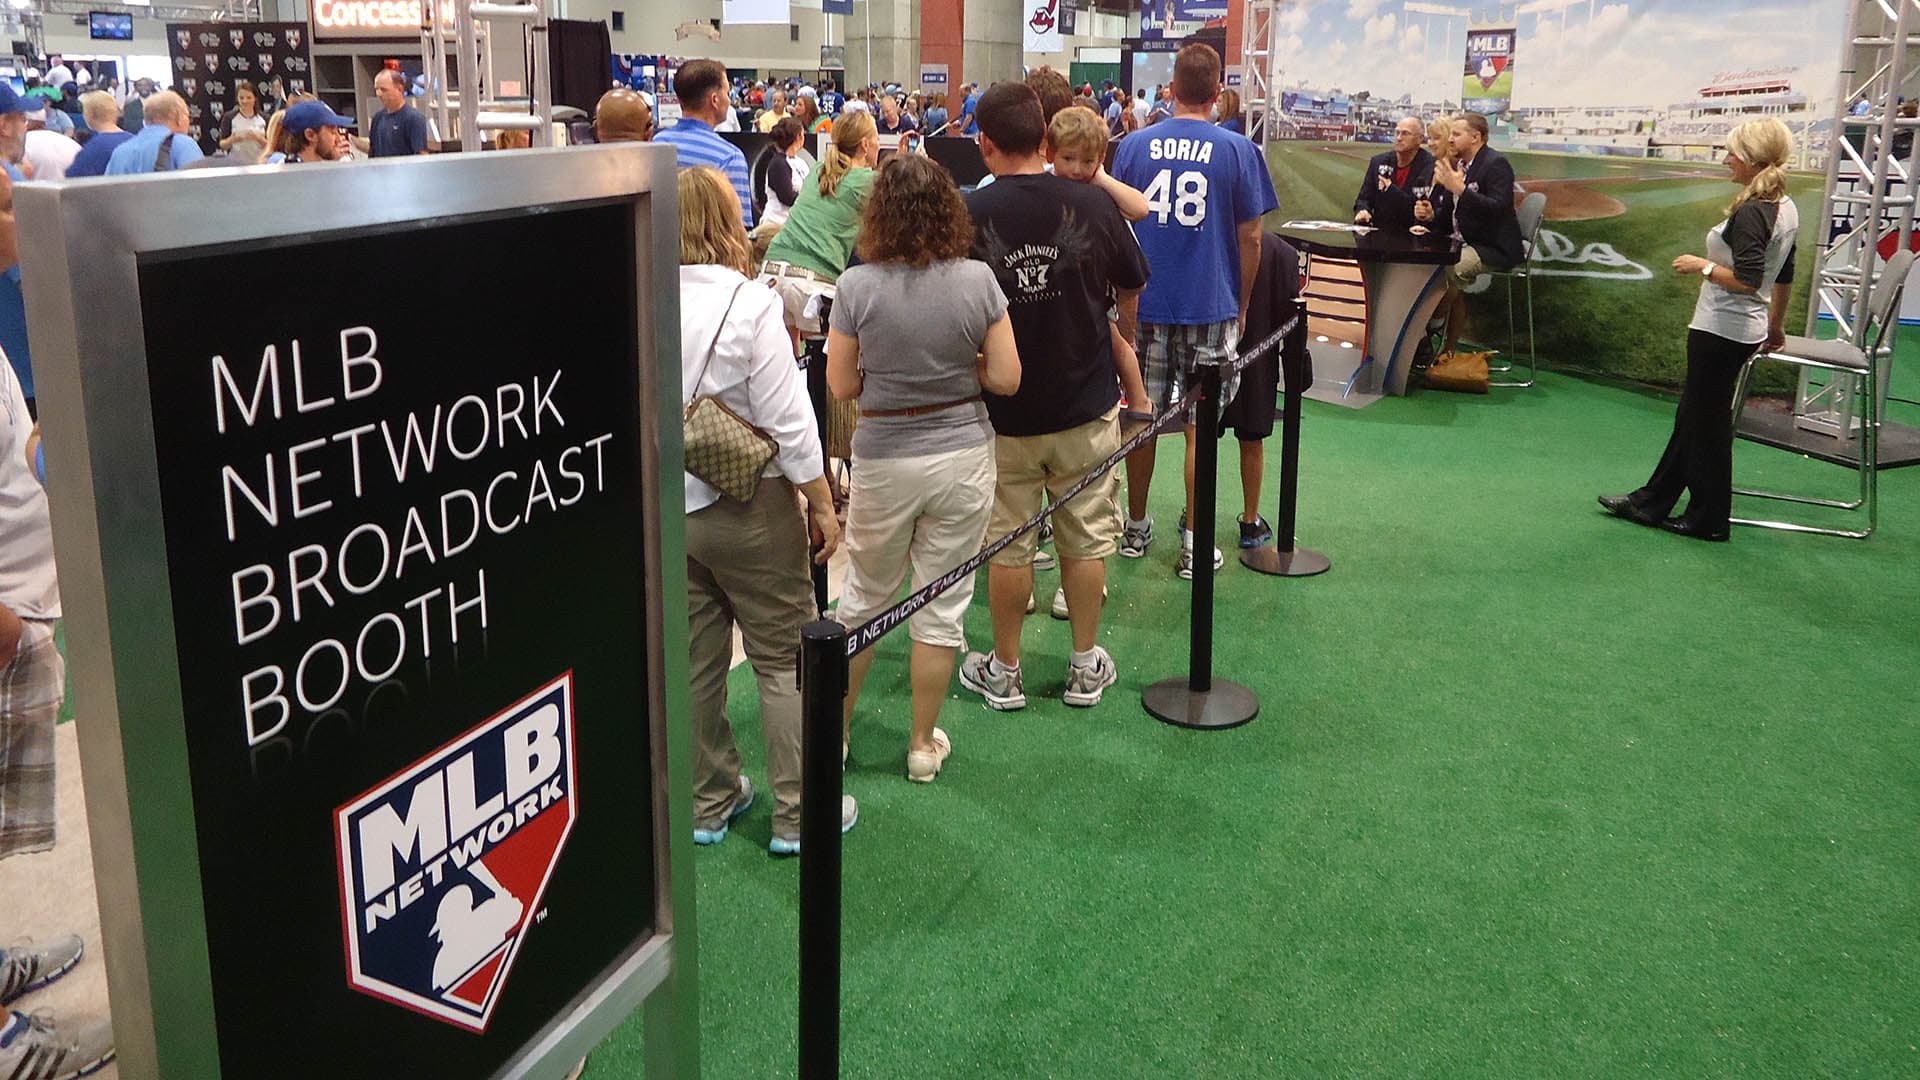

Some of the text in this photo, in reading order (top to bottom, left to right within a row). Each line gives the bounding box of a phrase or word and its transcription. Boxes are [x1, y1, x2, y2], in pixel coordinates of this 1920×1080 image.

[1473, 36, 1508, 51] MLB
[822, 101, 835, 113] 35
[1149, 138, 1213, 164] SORIA
[1143, 169, 1208, 226] 48
[1004, 248, 1026, 268] JACK
[1023, 258, 1040, 266] OLD
[212, 326, 383, 433] MLB
[222, 369, 565, 541] NETWORK
[232, 433, 613, 646] BROADCAST
[862, 589, 929, 645] NETWORK
[242, 568, 488, 747] BOOTH
[359, 703, 562, 902] MLB
[365, 775, 564, 933] NETWORK
[536, 906, 549, 925] TM
